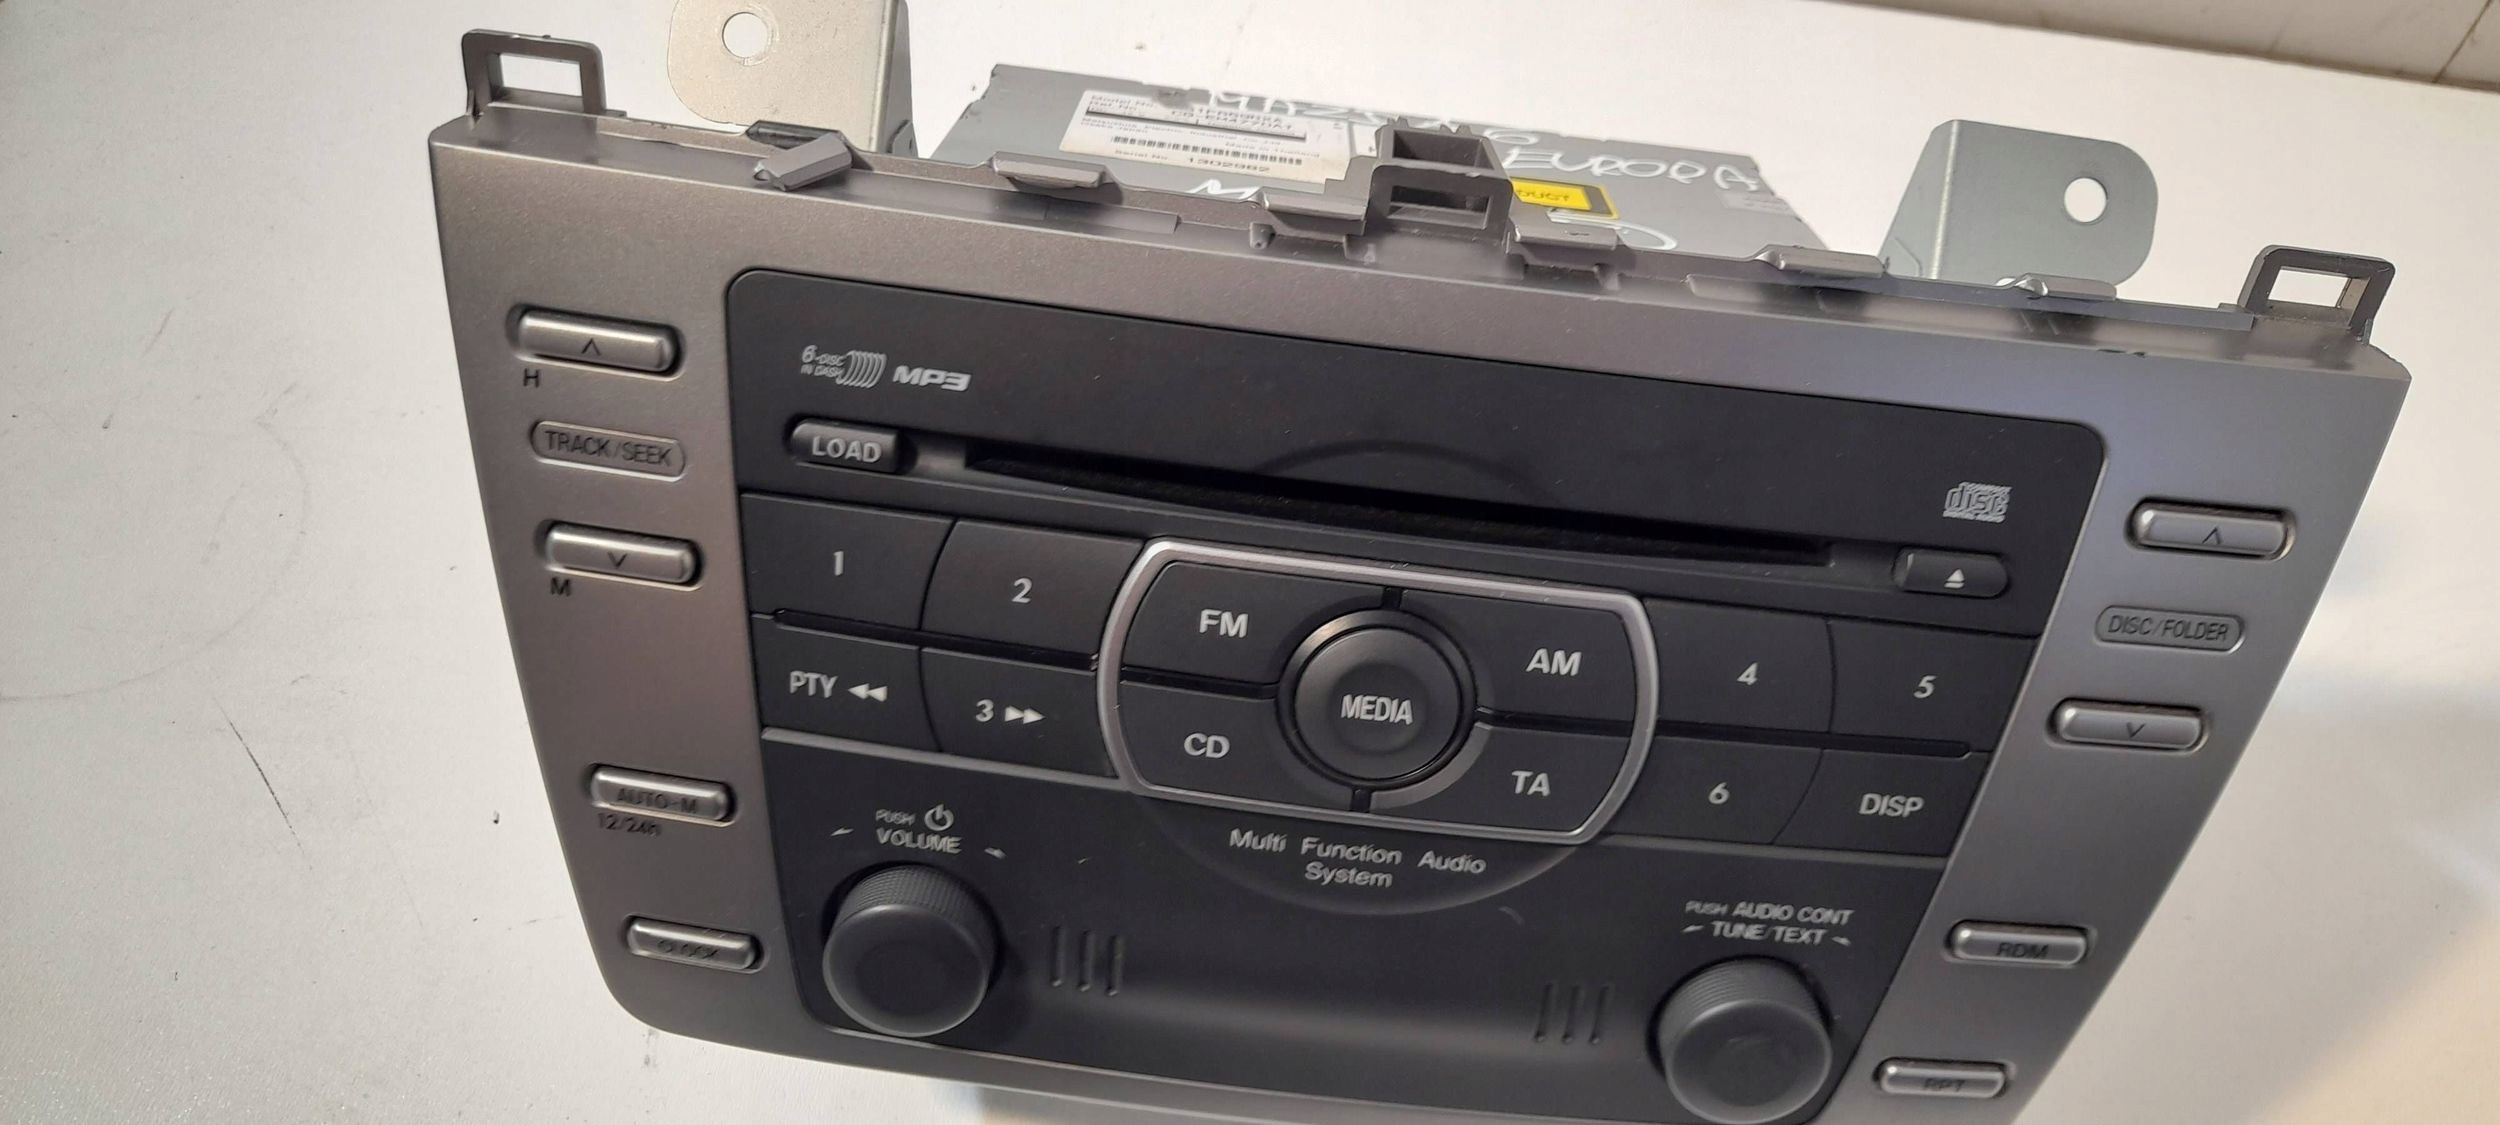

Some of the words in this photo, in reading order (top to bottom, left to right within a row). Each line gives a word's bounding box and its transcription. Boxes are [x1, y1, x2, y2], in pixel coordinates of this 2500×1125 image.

[523, 368, 541, 388] H
[892, 364, 973, 392] MP3
[544, 429, 673, 468] TRACK/SEEK
[811, 435, 882, 464] LOAD
[833, 550, 845, 577] 1
[550, 577, 572, 597] M
[1011, 577, 1033, 604] 2
[1198, 608, 1249, 639] FM
[2107, 614, 2232, 643] DISC/FOLDER
[1525, 647, 1583, 678] AM
[1735, 662, 1759, 686] 4
[788, 670, 839, 699] PTY
[1913, 675, 1938, 700] 5
[975, 698, 995, 723] 3
[1339, 693, 1414, 727] MEDIA
[1183, 732, 1231, 760] CD
[1511, 769, 1553, 798] TA
[1708, 781, 1731, 806] 6
[616, 787, 697, 815] AUTO-M
[1858, 792, 1925, 819] DISP
[875, 808, 916, 827] PUSH
[875, 827, 963, 855] VOLUME
[1228, 827, 1289, 854] Multi
[1299, 837, 1403, 866] Function
[1417, 850, 1487, 875] Audio
[1303, 861, 1394, 889] System
[1685, 900, 1729, 917] PUSH
[1731, 900, 1795, 922] AUDIO
[1796, 905, 1856, 926] CONT
[1710, 920, 1829, 946] TUNE/TEXT
[1996, 940, 2050, 960] RDM
